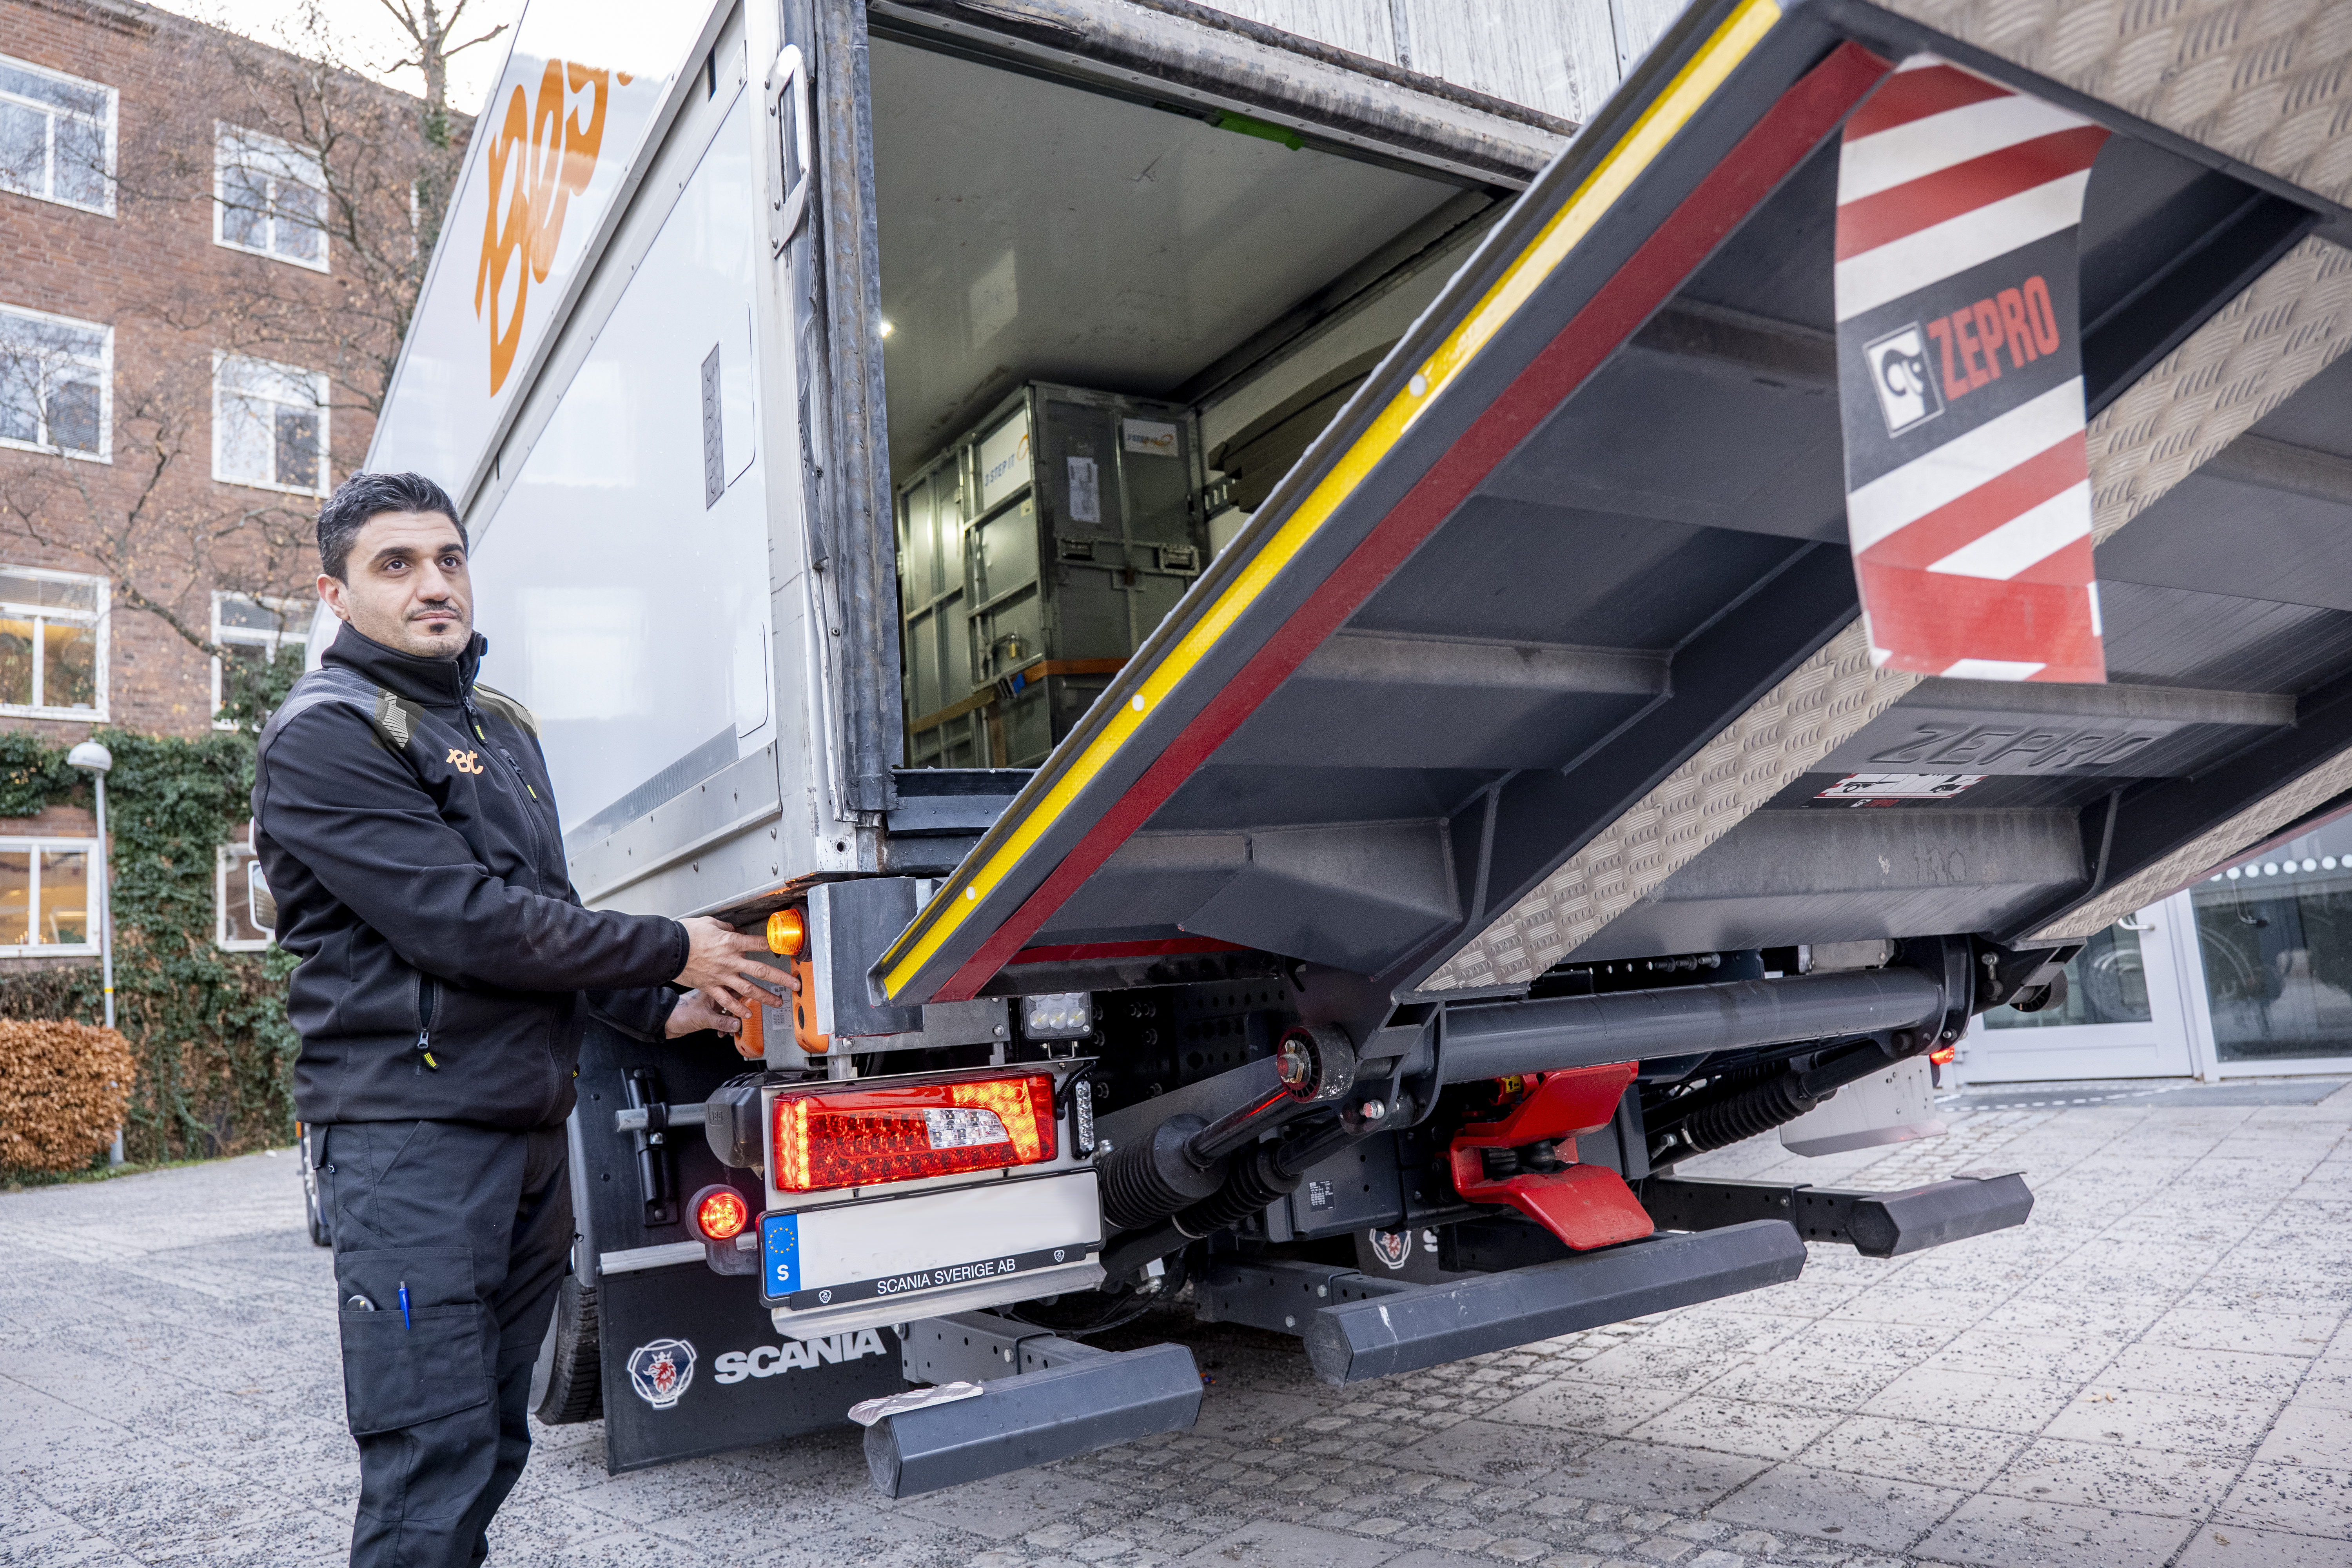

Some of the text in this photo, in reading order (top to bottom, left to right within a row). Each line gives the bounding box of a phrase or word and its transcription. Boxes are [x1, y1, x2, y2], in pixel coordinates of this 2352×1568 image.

[1926, 275, 2060, 401] ZEPRO
[990, 460, 1007, 483] STEP
[1867, 722, 2158, 767] ZEPRO
[777, 1264, 789, 1281] S
[877, 1258, 1016, 1294] SCANIA SVERIGE AB
[714, 1328, 887, 1384] SCANIA
